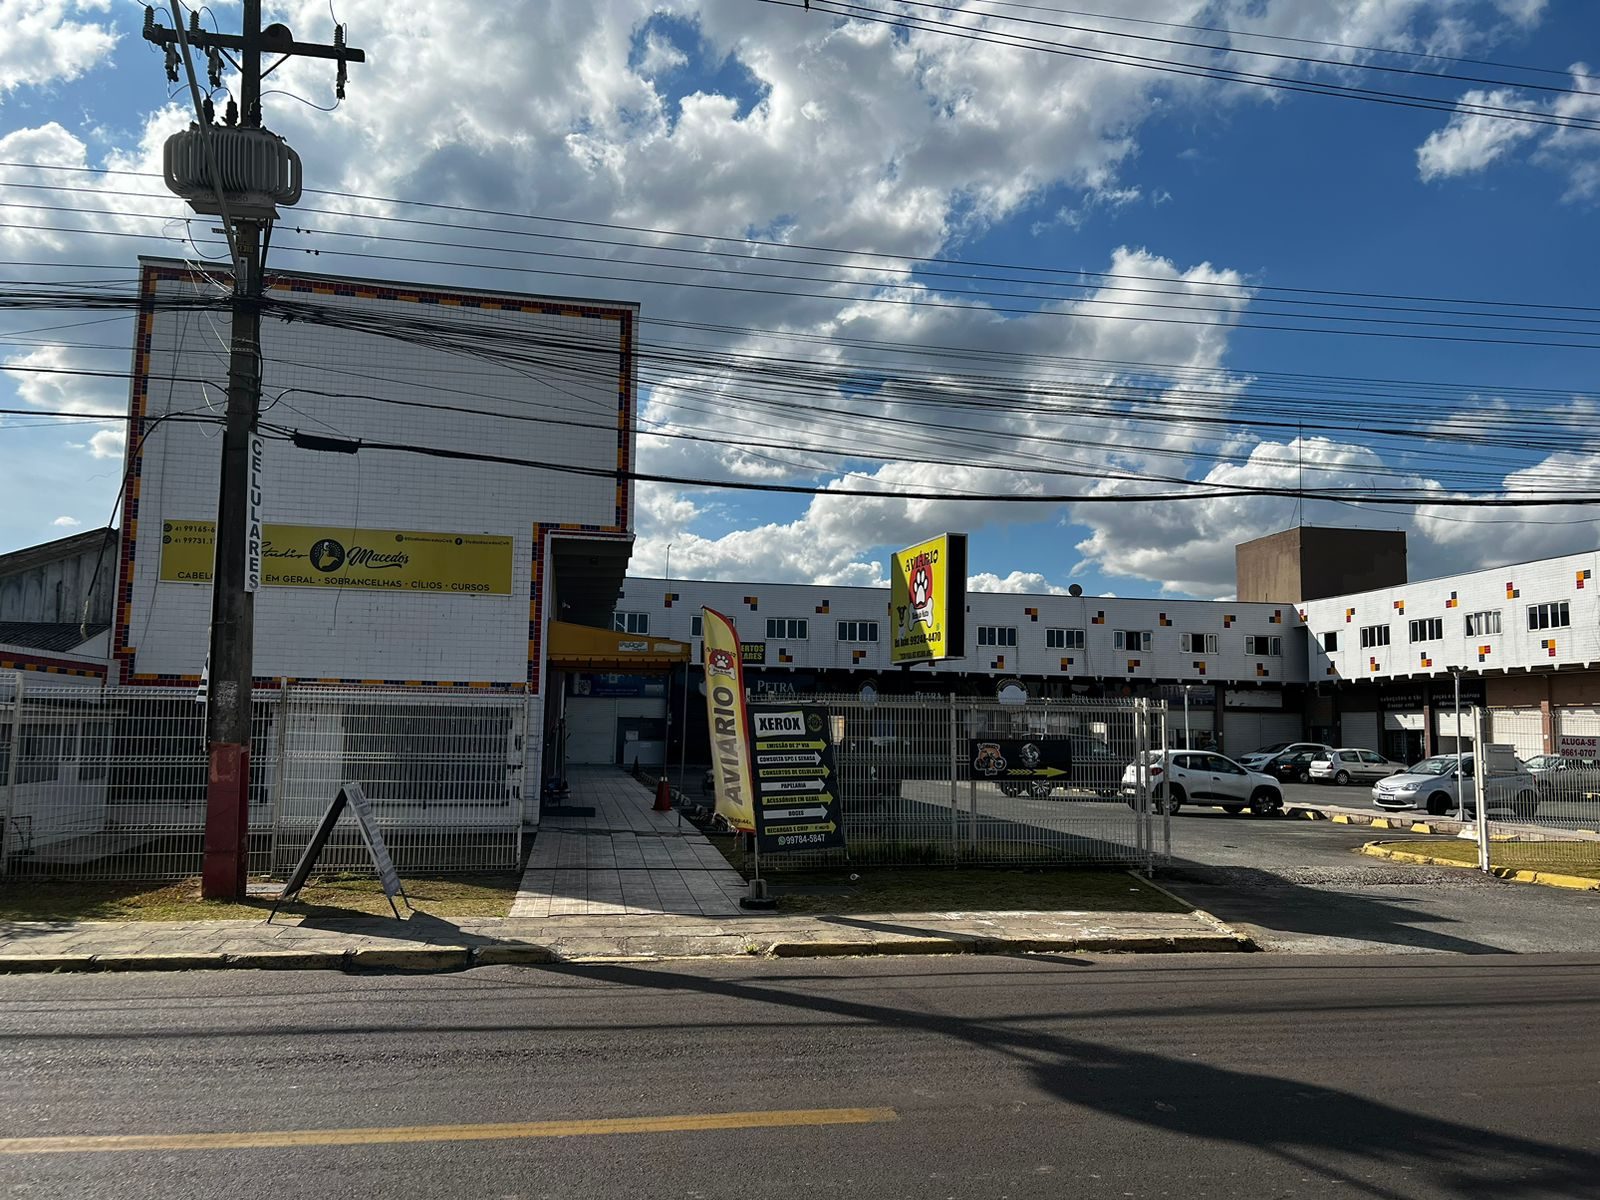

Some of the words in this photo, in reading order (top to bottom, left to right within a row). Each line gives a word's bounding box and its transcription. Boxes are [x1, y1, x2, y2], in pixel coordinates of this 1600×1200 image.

[249, 438, 262, 592] CELULARES
[183, 525, 215, 533] 99165-6
[177, 571, 213, 580] CABEL
[265, 574, 280, 582] EM
[282, 575, 315, 584] GERAL
[324, 576, 402, 588] SOBRANCELHAS
[411, 580, 443, 590] CÍLIOS
[451, 582, 490, 592] CURSOS
[759, 717, 801, 731] XEROX
[1561, 738, 1597, 746] ALUGA-SE
[1560, 748, 1597, 757] 9661-0707
[766, 826, 793, 834] RECARGAS
[785, 834, 825, 845] 99784-5847
